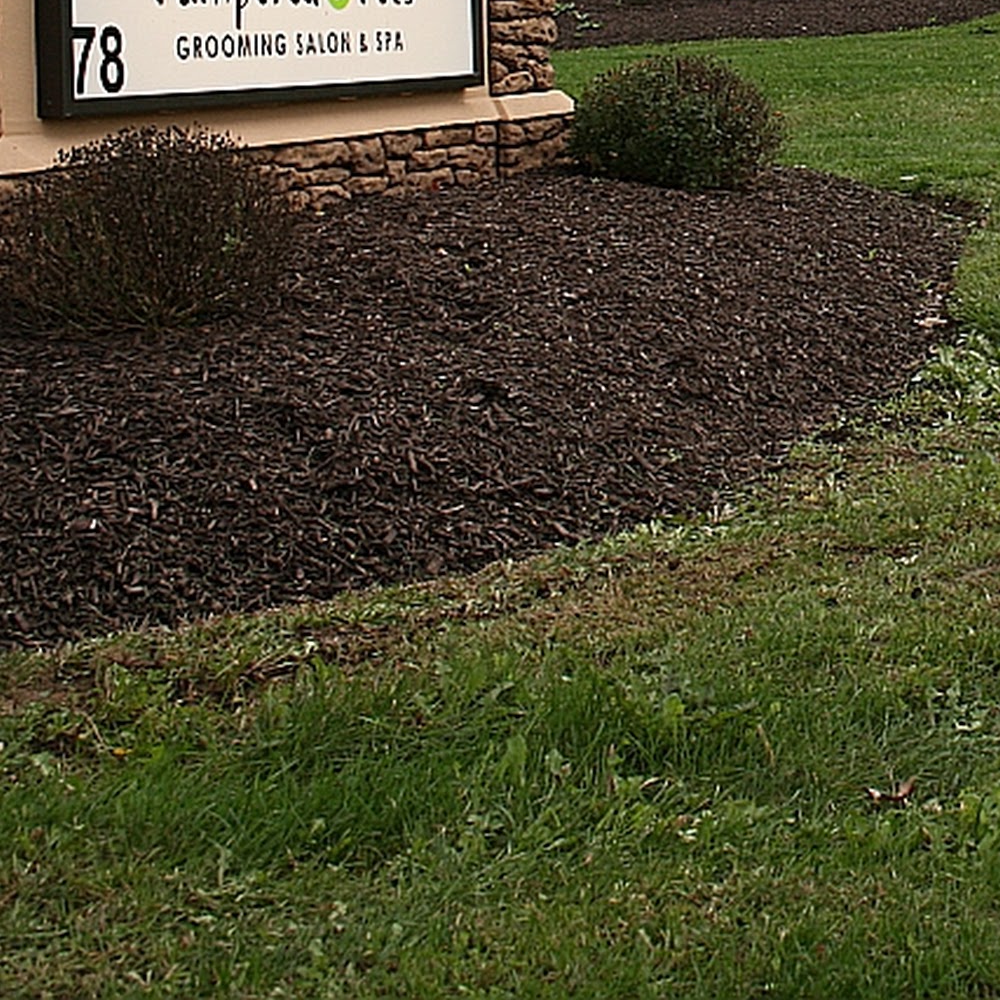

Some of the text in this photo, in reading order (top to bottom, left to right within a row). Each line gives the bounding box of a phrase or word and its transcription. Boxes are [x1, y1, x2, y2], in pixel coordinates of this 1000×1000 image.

[71, 25, 125, 95] 78
[176, 31, 404, 61] GROOMING SALON & SPA
